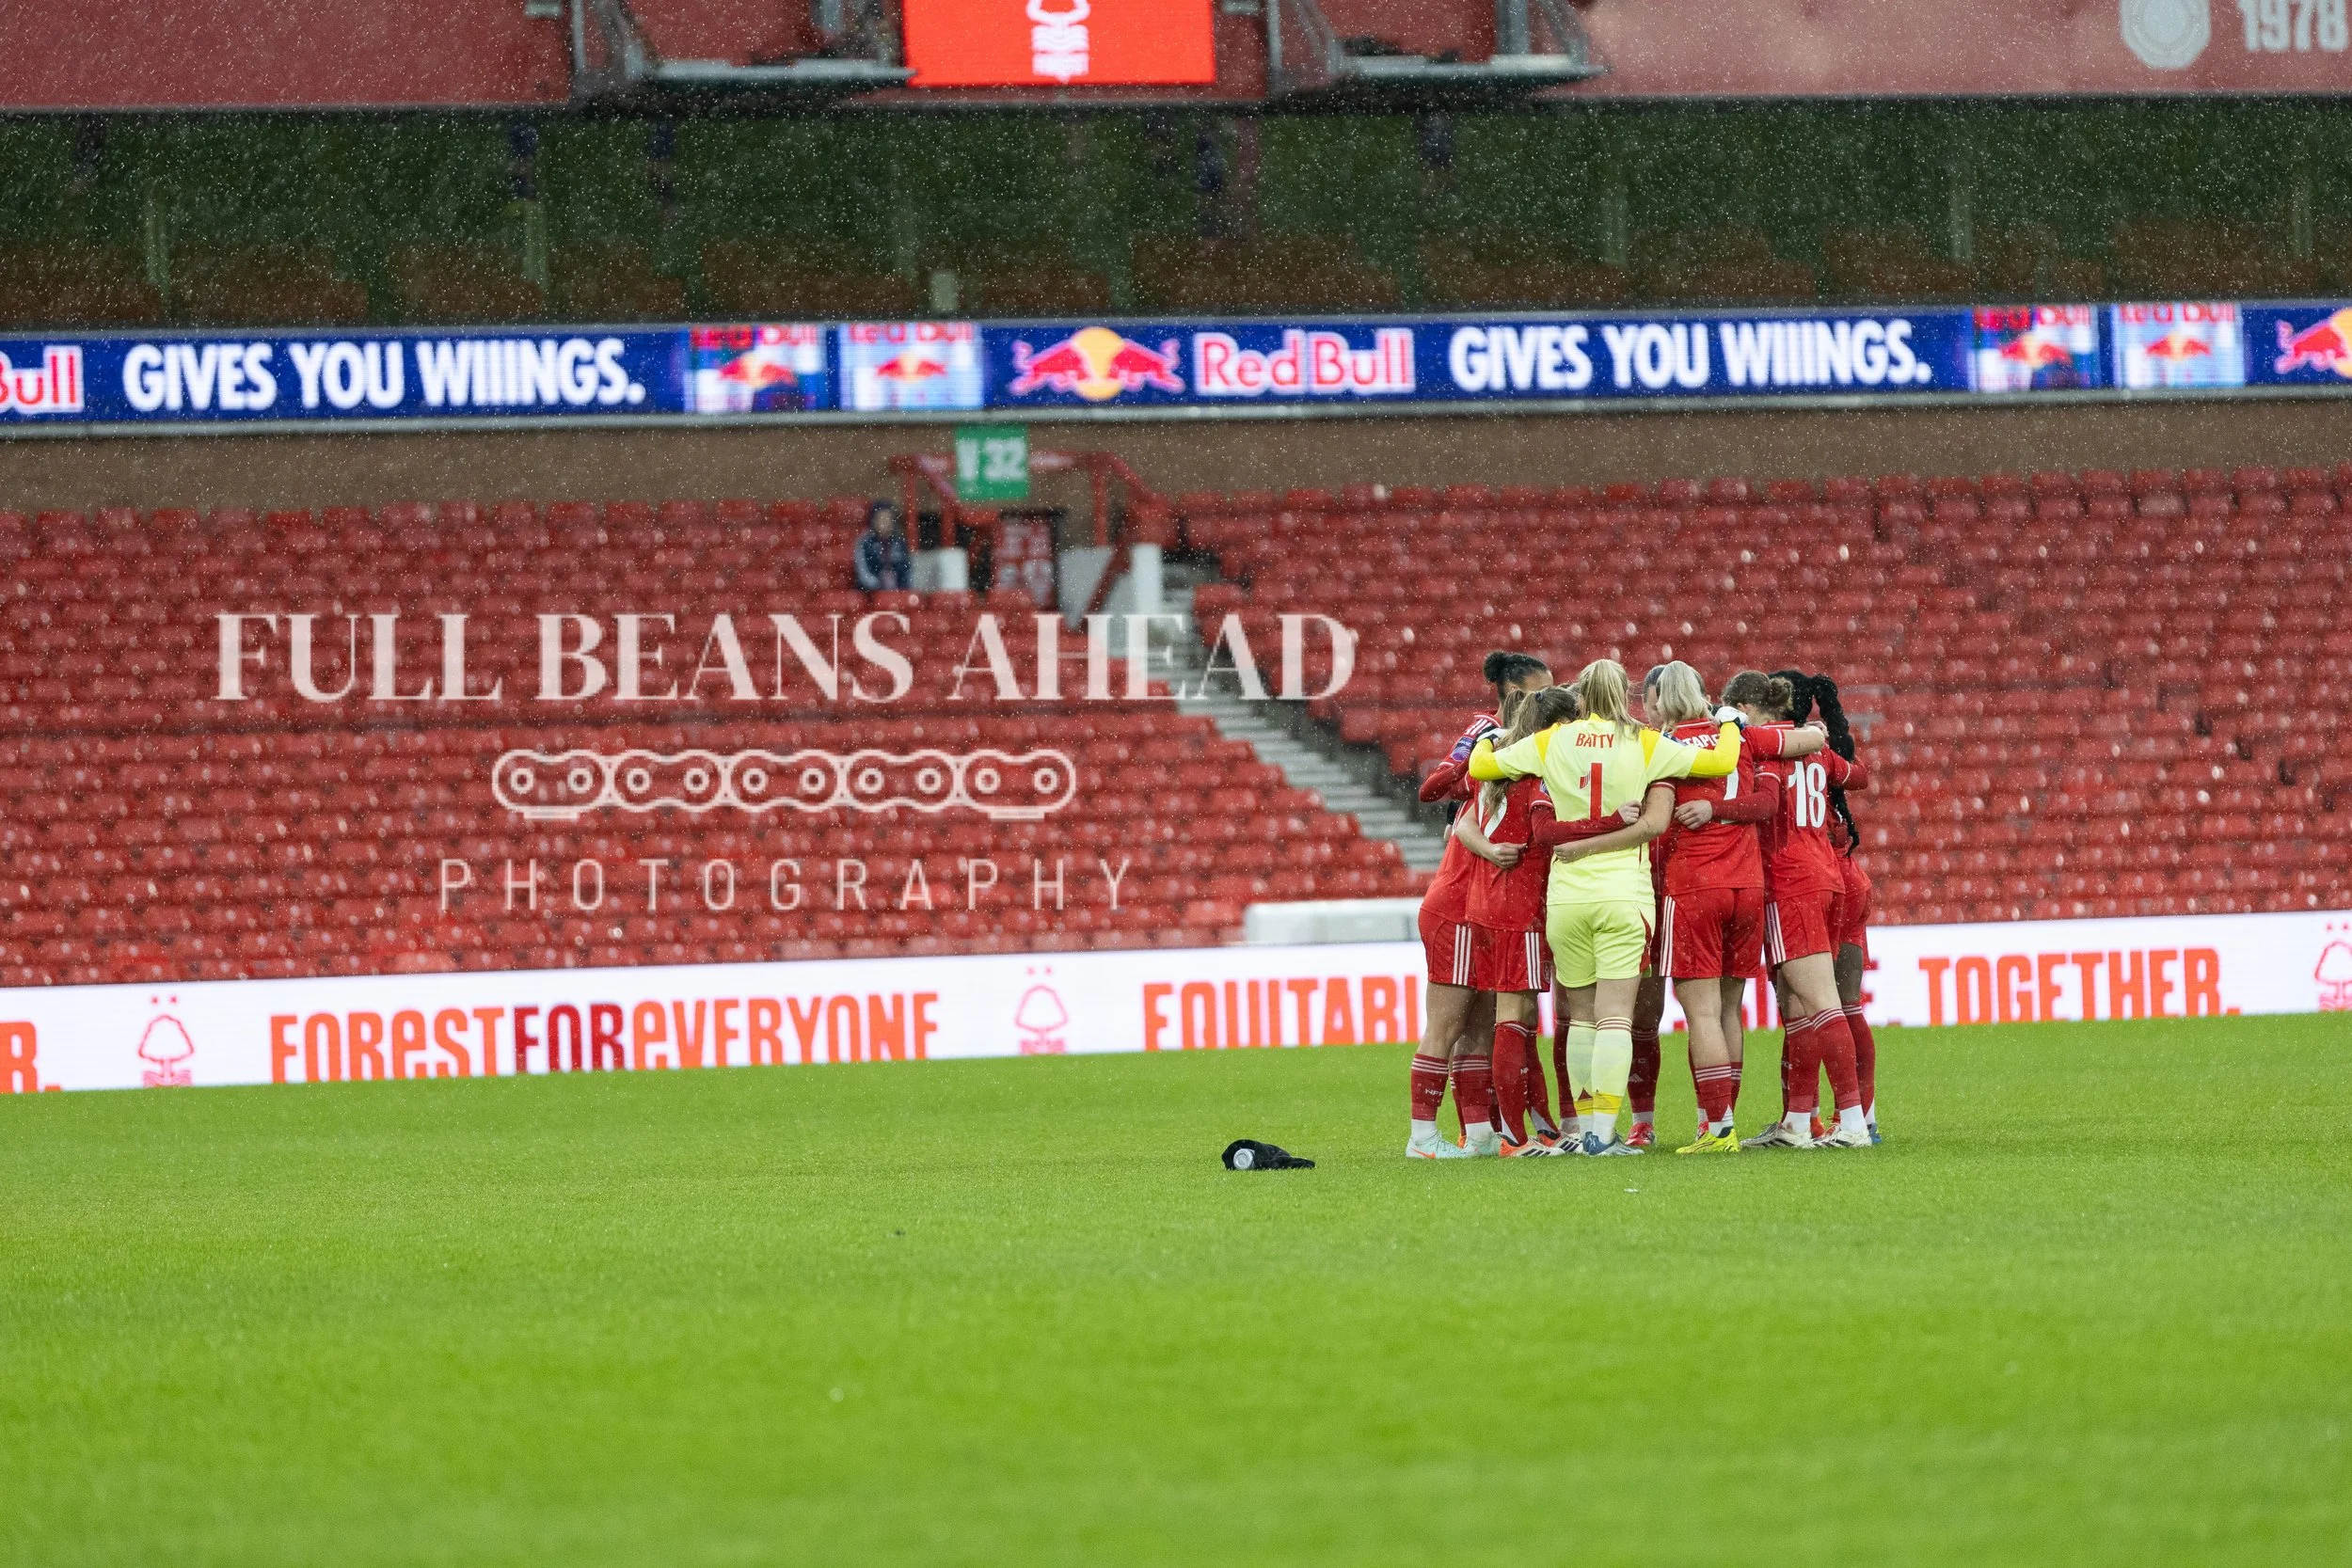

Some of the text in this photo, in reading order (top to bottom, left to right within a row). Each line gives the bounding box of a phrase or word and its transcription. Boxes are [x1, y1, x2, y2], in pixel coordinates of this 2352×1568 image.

[122, 337, 645, 412] GIVES YOU WIIINGS.
[1196, 330, 1414, 395] Red Bull
[1450, 318, 1932, 391] GIVES YOU WIIINGS.
[1576, 733, 1614, 749] BATTY
[1580, 762, 1602, 820] 1
[1788, 761, 1826, 828] 18
